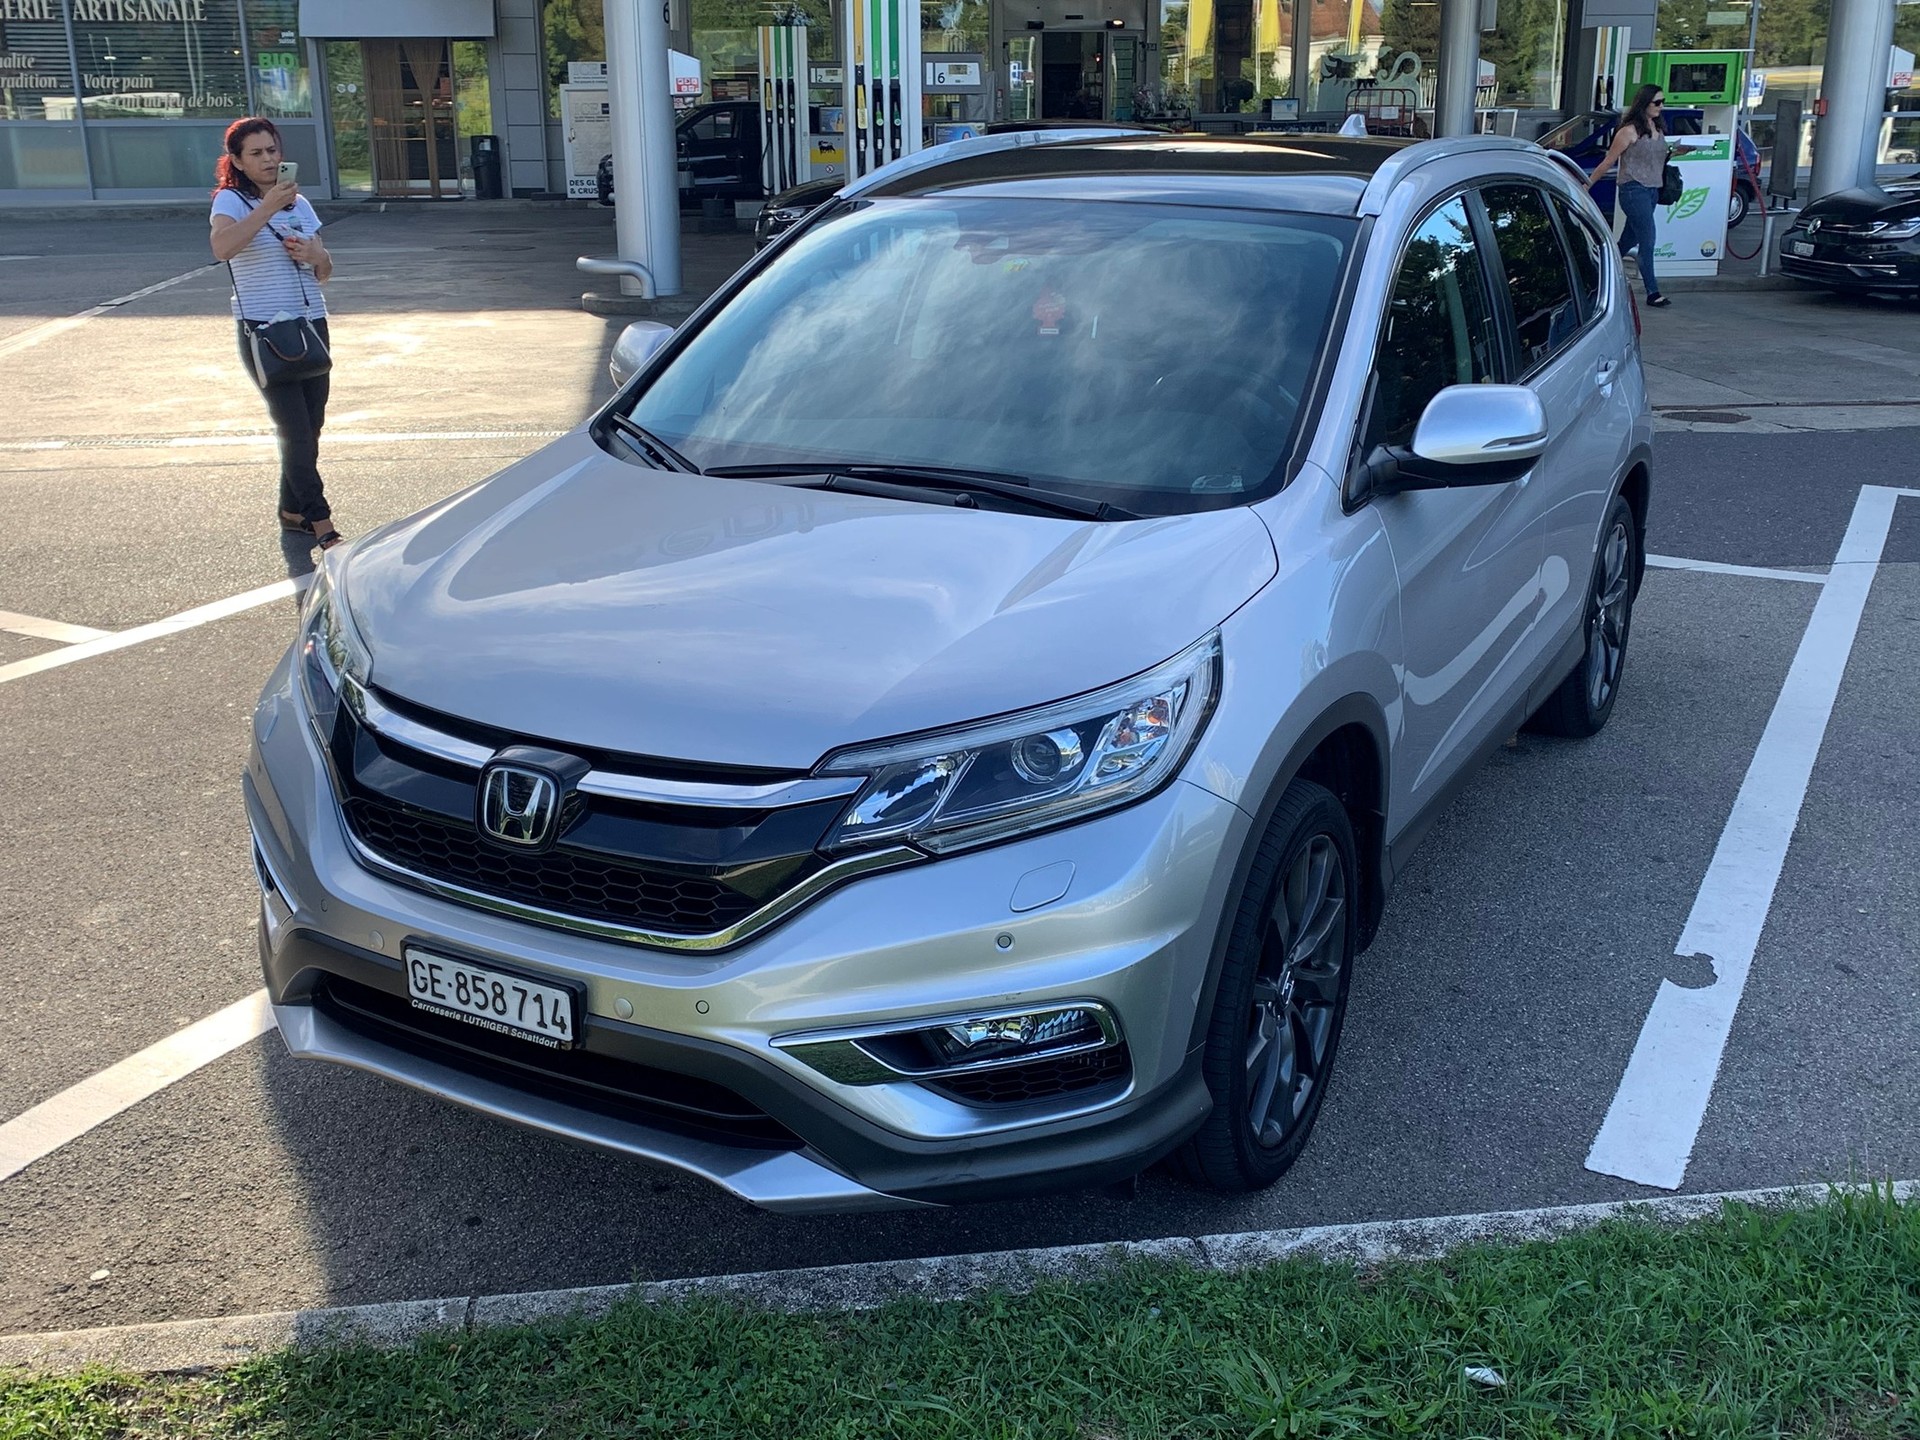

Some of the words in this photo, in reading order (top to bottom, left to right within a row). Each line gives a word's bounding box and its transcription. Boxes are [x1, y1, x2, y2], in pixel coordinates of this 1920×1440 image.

[0, 0, 55, 19] ERIE
[73, 0, 207, 21] ARTISANALE
[83, 74, 119, 89] Votre
[122, 74, 153, 92] pain
[937, 72, 945, 84] 6
[188, 92, 203, 108] de
[207, 92, 233, 107] bois
[411, 999, 461, 1021] Carrosserie
[463, 1013, 508, 1035] LUTHIGER
[510, 1028, 558, 1049] Schattdorf
